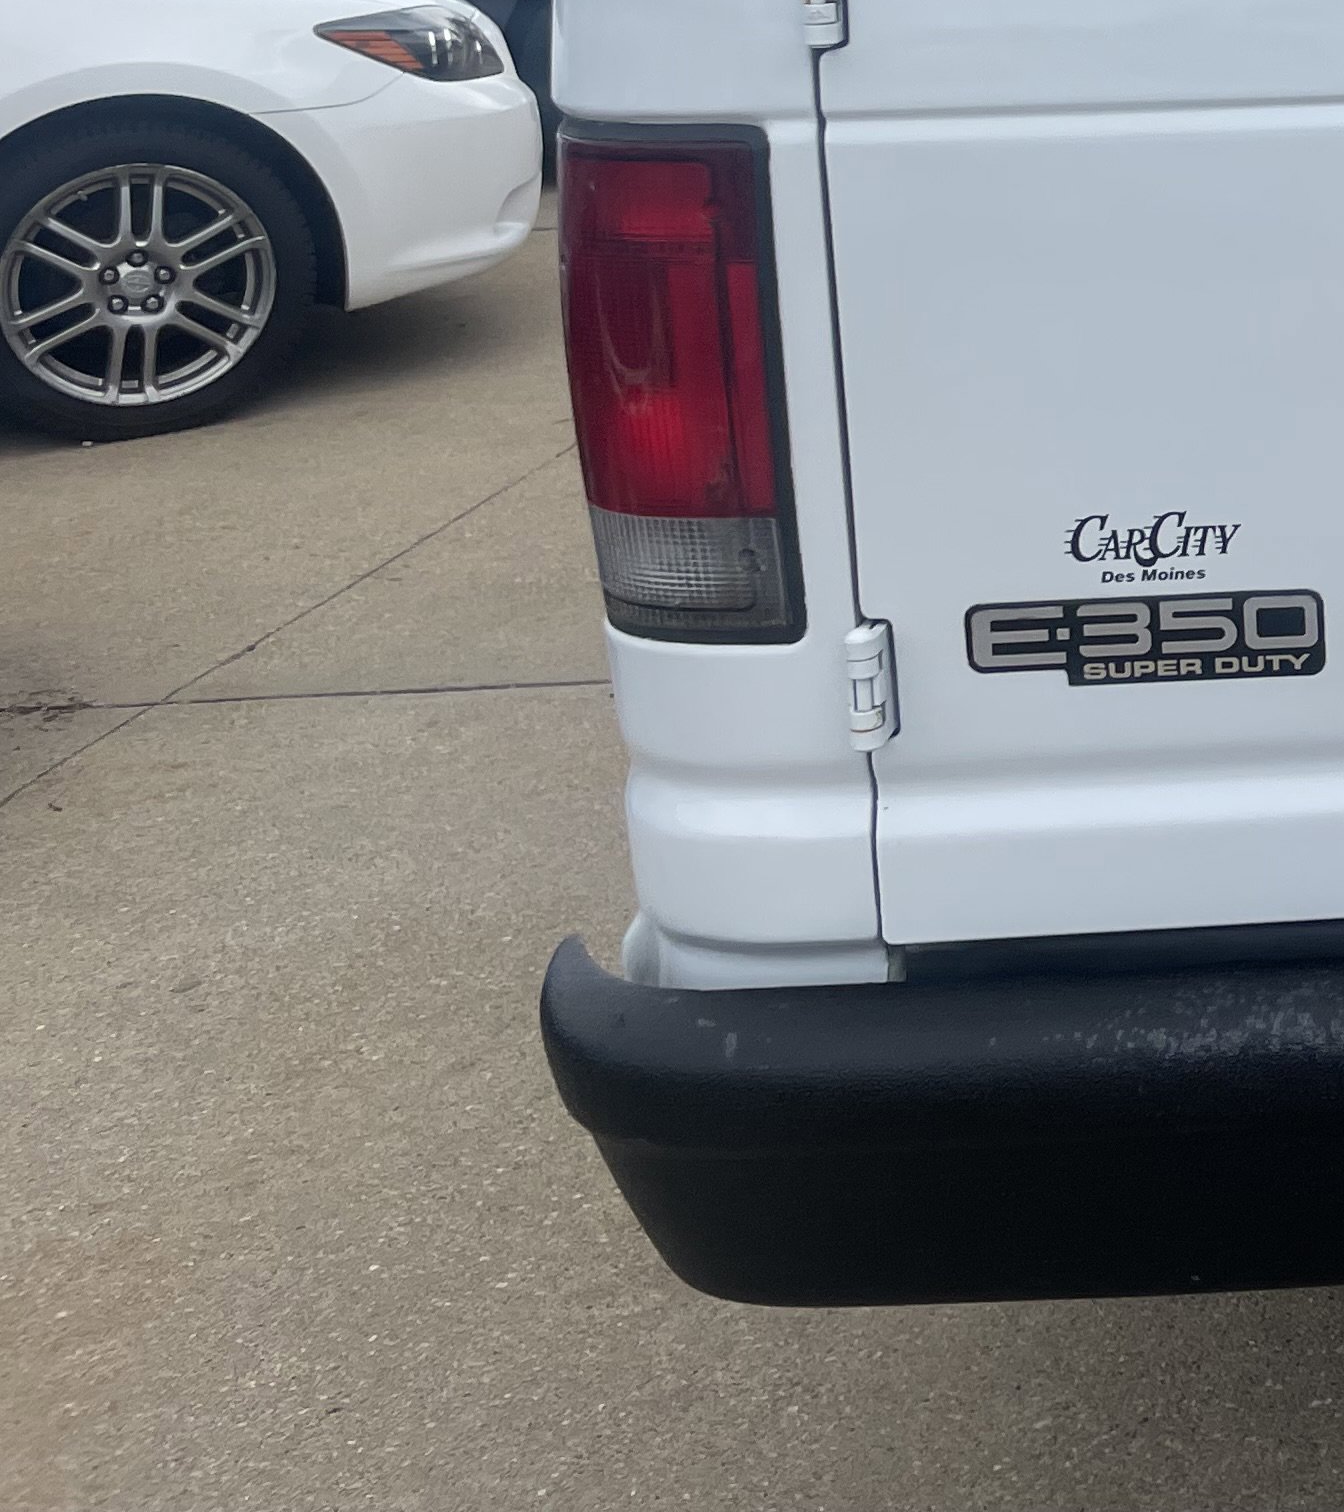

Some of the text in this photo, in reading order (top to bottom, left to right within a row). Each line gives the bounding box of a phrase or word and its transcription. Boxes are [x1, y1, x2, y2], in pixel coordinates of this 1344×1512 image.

[1101, 567, 1207, 584] Des Moines
[1083, 653, 1311, 680] SUPER DUTY
